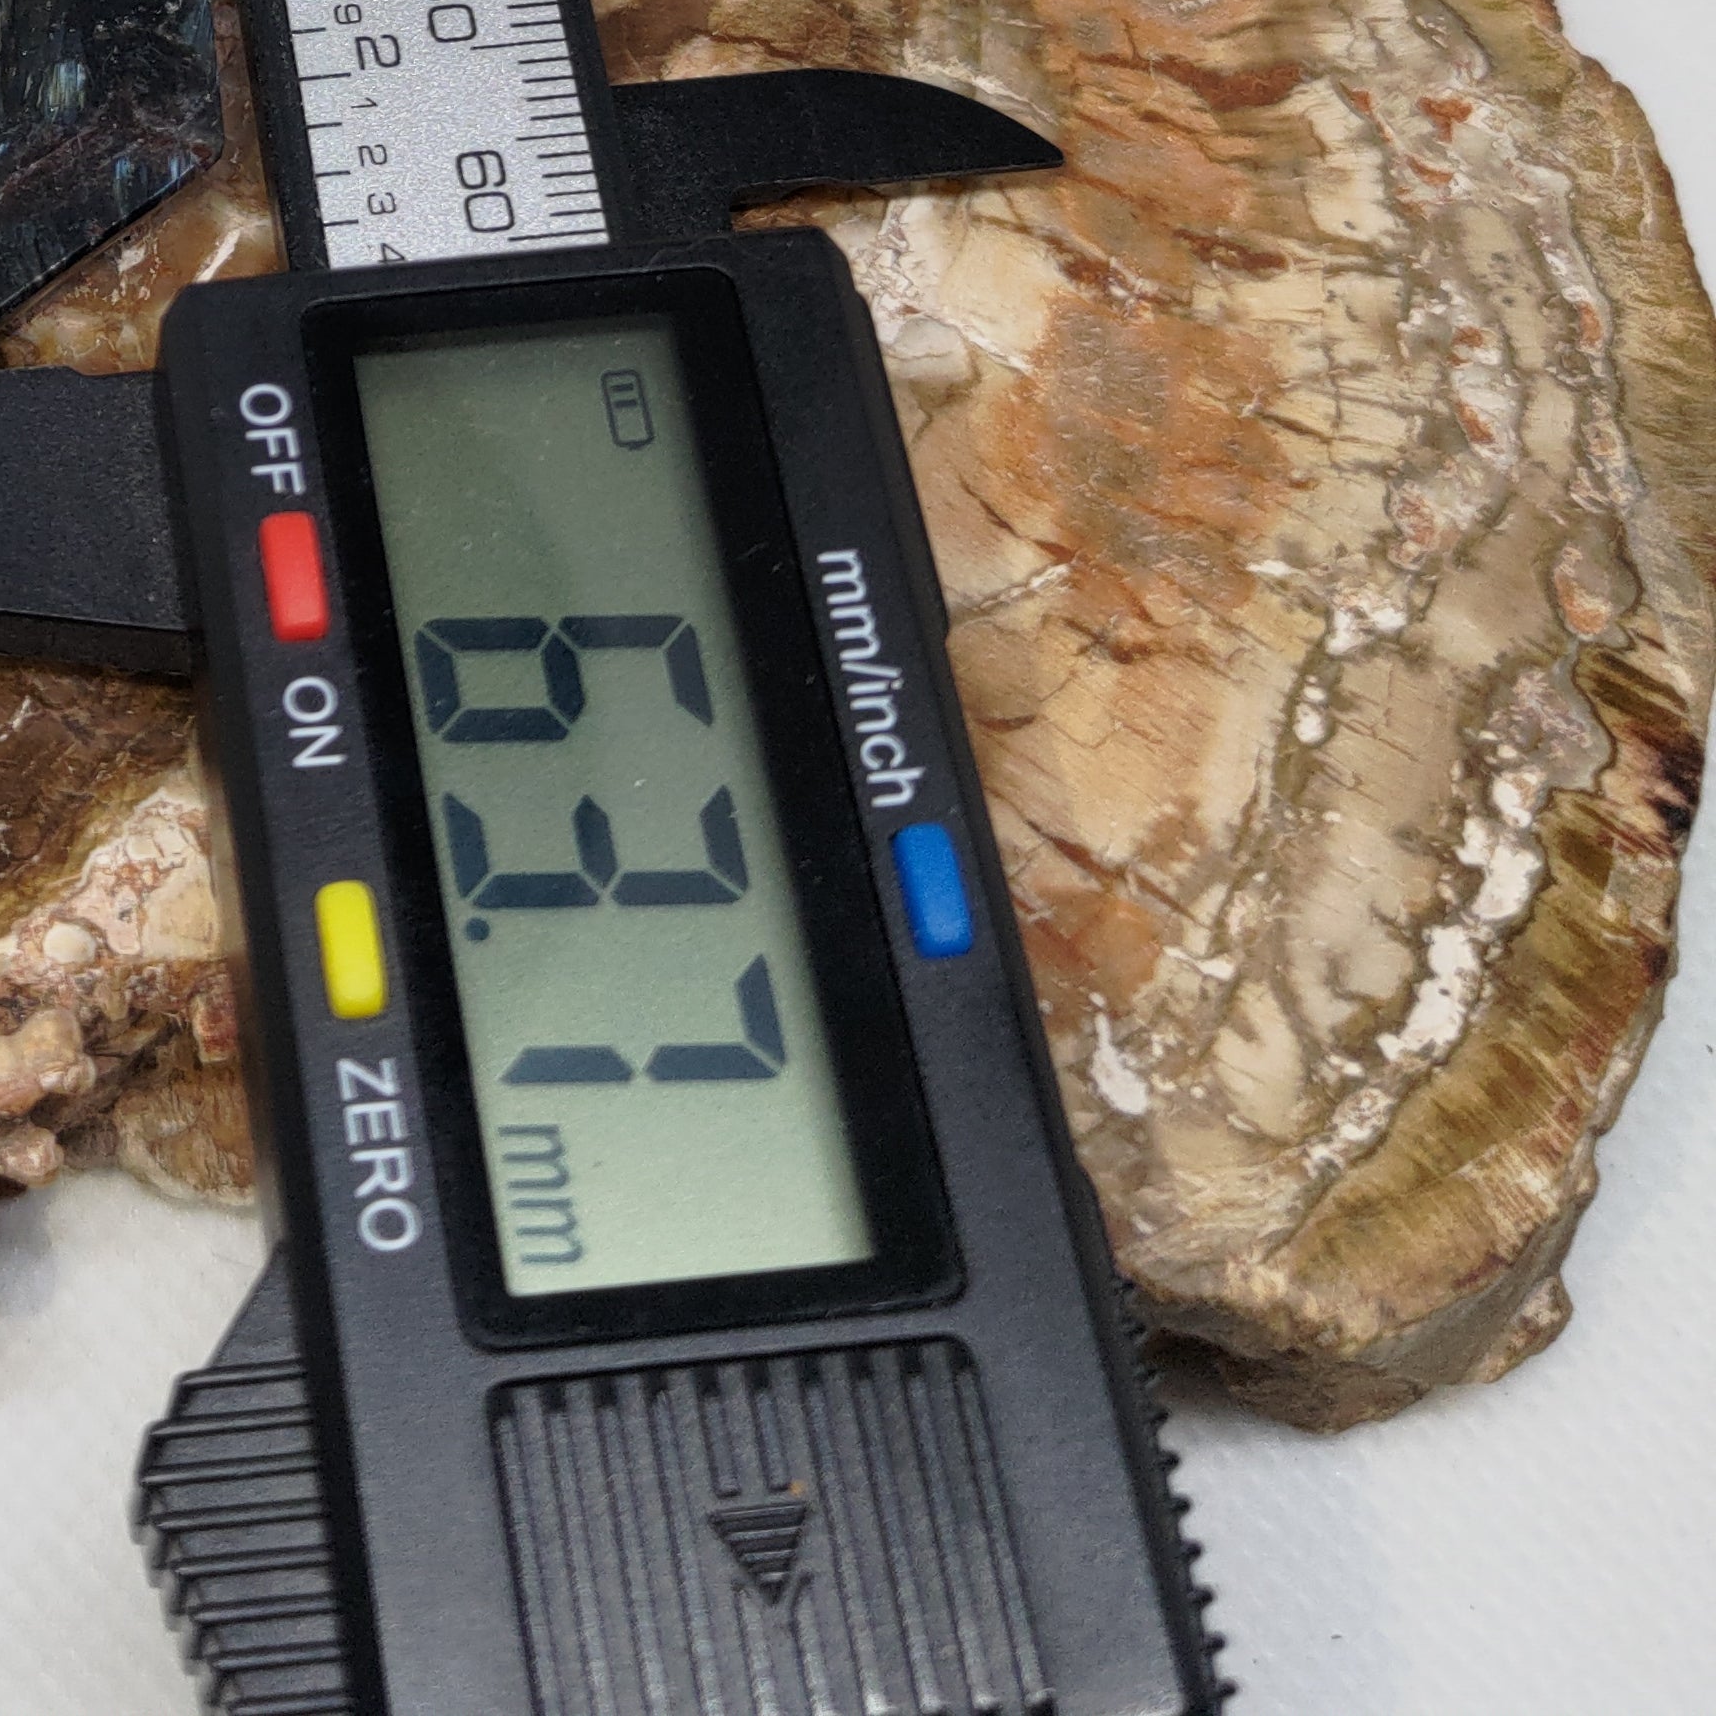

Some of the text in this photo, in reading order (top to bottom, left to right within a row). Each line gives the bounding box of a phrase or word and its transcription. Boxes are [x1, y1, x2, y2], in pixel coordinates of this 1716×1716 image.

[332, 2, 364, 26] 9
[353, 33, 402, 72] 2
[350, 96, 379, 110] 1
[356, 143, 389, 168] 2
[366, 191, 399, 216] 3
[454, 149, 516, 234] 60
[378, 242, 406, 264] 4
[239, 382, 307, 496] OFF
[815, 547, 927, 809] mm/inch
[282, 675, 348, 769] ON
[414, 614, 787, 1266] 63.7 mm
[335, 1056, 422, 1253] ZERO
